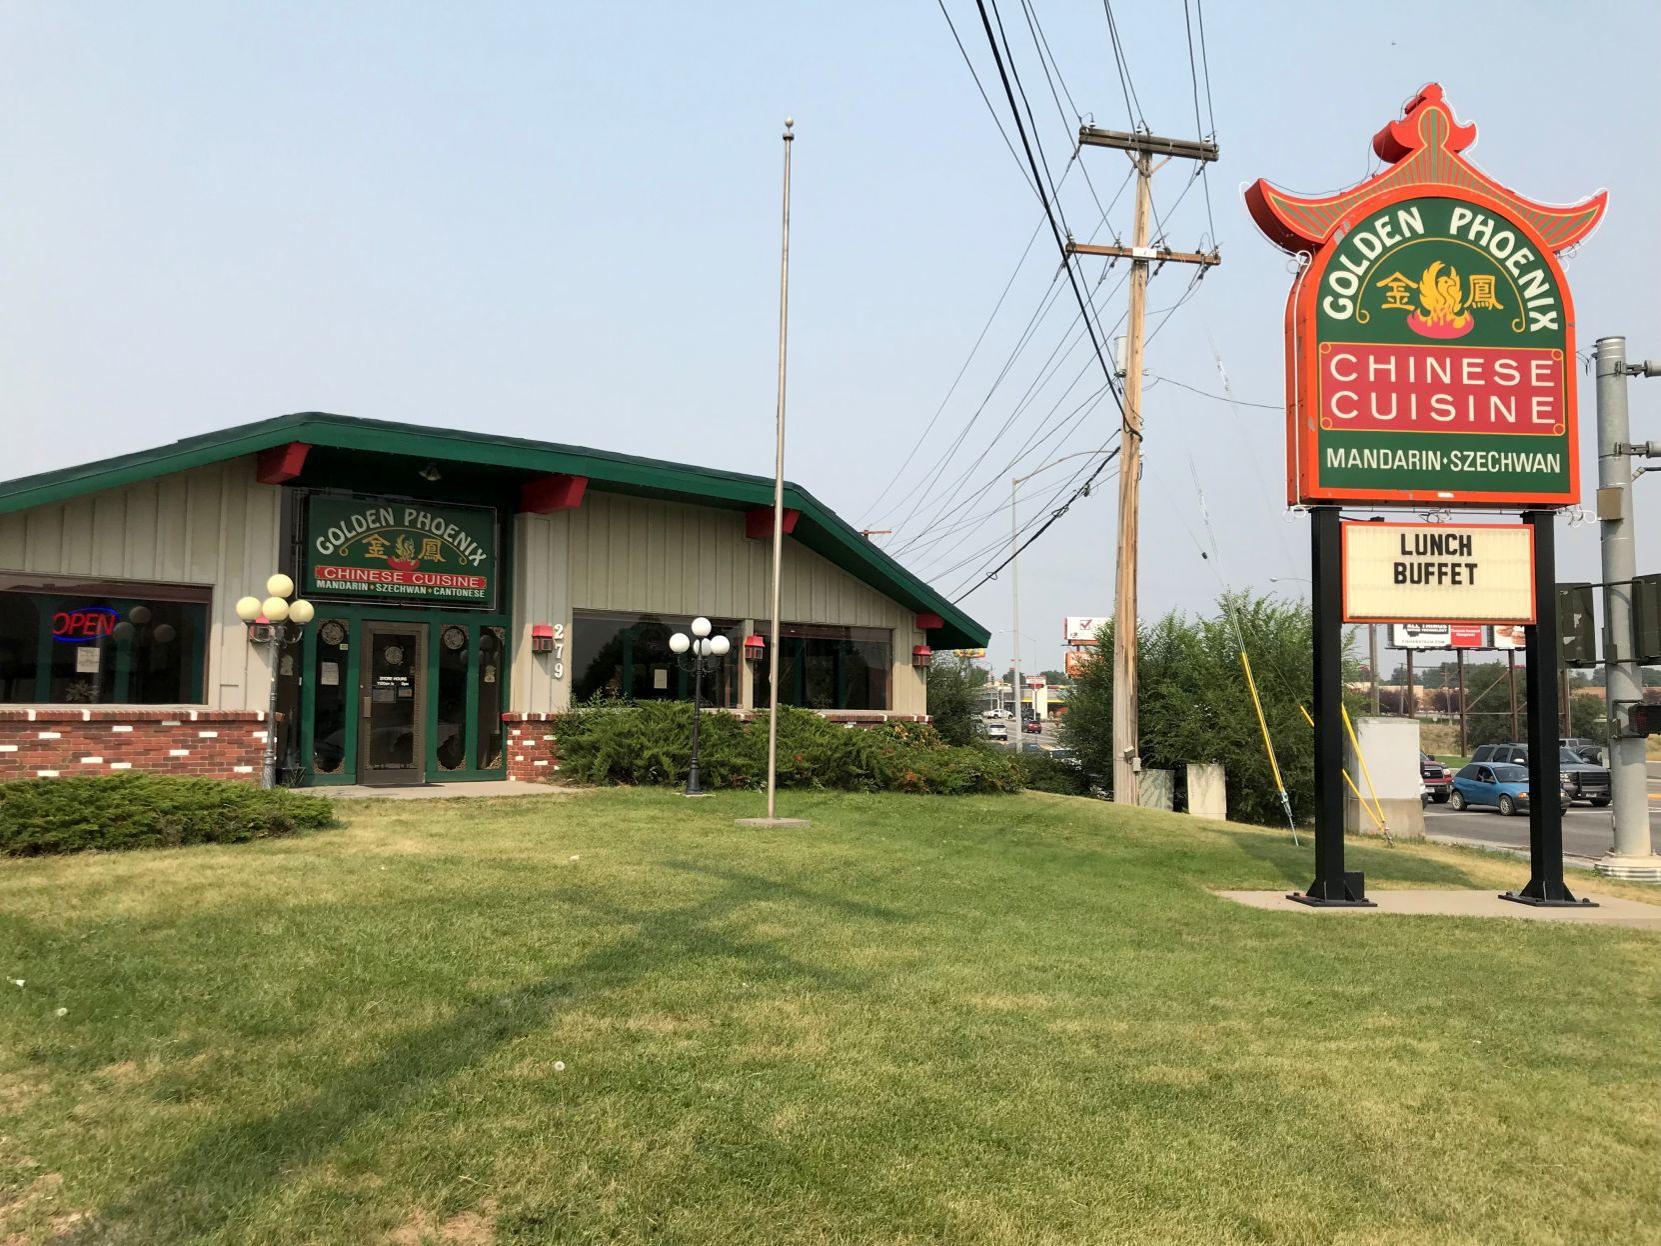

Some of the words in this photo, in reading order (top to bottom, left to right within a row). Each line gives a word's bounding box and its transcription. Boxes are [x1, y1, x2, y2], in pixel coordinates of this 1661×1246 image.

[1323, 206, 1425, 320] GOLDEN
[1449, 206, 1559, 332] PHOENIX
[1376, 271, 1419, 311] 金
[1464, 274, 1504, 311] 鳳
[1329, 353, 1555, 387] CHINESE
[1330, 390, 1556, 424] CUISINE
[1326, 448, 1441, 471] MANDARIN
[1450, 450, 1561, 473] SZECHWAN
[316, 507, 395, 555] GOLDEN
[403, 508, 487, 567] PHOENIX
[362, 534, 391, 559] 金
[1400, 533, 1472, 557] LUNCH
[324, 567, 404, 583] CHINESE
[412, 573, 480, 588] CUISINE
[1393, 562, 1478, 586] BUFFET
[316, 580, 369, 591] MANDARIN
[375, 583, 427, 595] SZECHWAN
[433, 587, 485, 598] CANTONESE
[51, 611, 116, 635] OPEN
